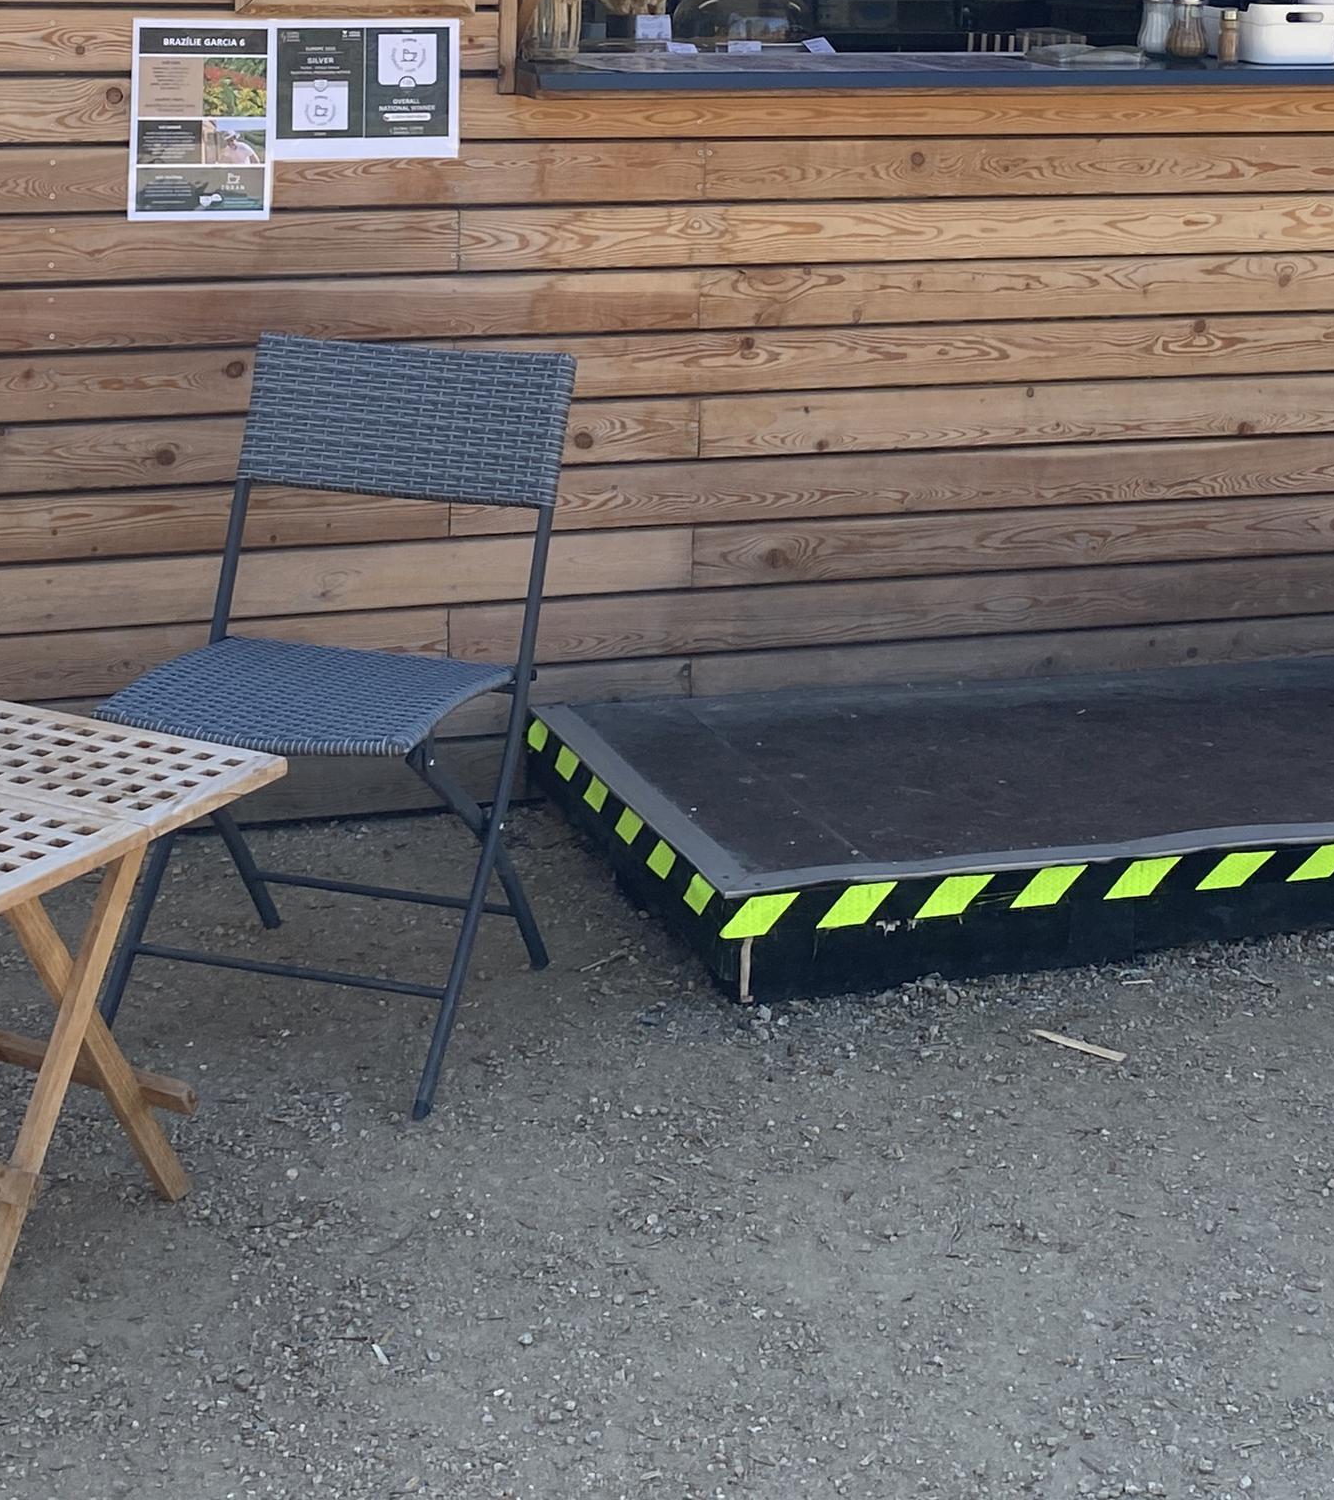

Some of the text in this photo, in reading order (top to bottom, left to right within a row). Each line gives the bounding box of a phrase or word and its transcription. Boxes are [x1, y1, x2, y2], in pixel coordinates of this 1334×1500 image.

[163, 36, 245, 47] BRAZÍLIE GARCIA 6
